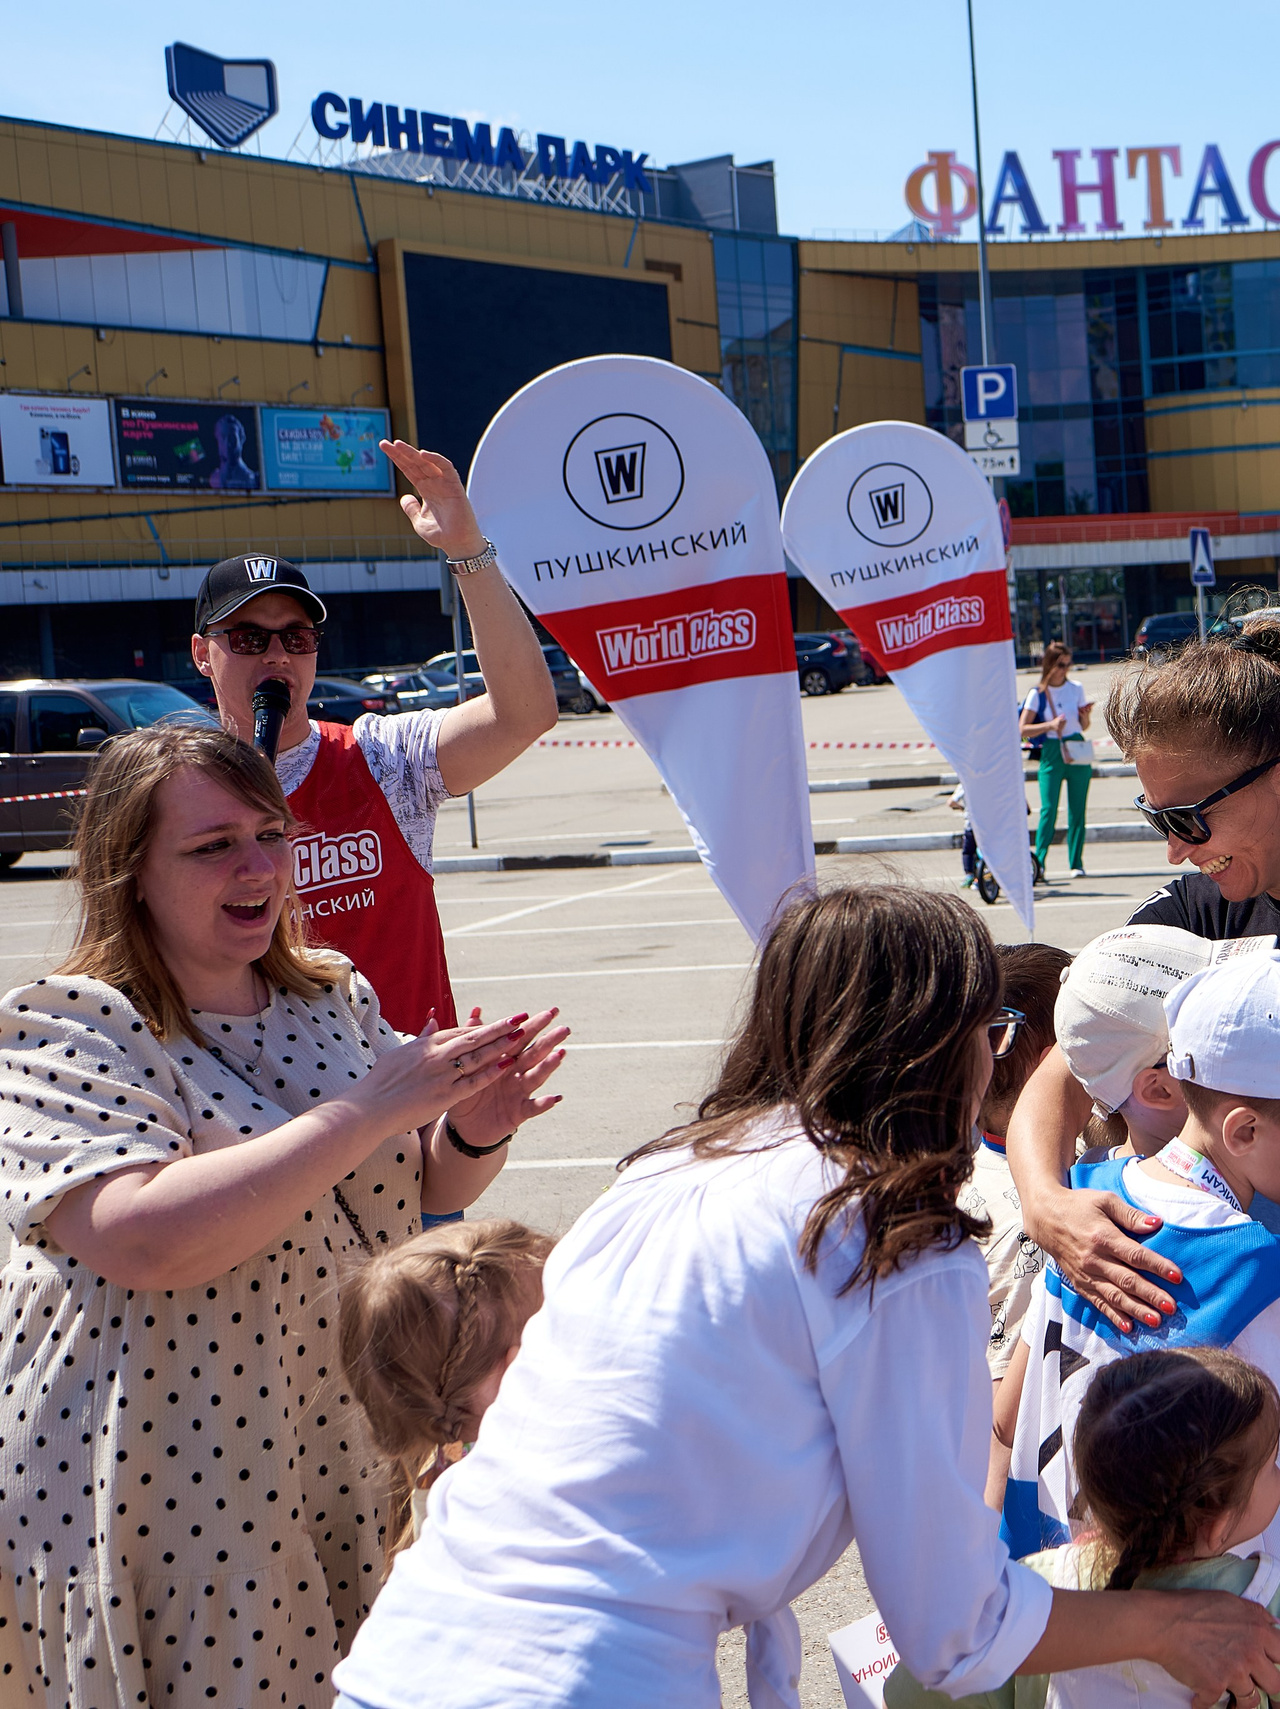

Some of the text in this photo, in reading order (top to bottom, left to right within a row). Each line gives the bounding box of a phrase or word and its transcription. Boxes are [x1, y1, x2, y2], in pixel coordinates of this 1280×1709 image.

[311, 91, 651, 193] СИНЕМА ПАРК
[604, 451, 638, 496] W
[875, 490, 900, 523] W
[250, 559, 272, 579] W
[534, 520, 748, 582] ПУШКИНСКИЙ
[830, 535, 980, 588] ПУШКИНСКИЙ
[603, 613, 750, 670] World Class
[882, 598, 981, 650] World Class
[294, 836, 377, 888] Class
[1201, 1169, 1242, 1212] ЛИКАМ
